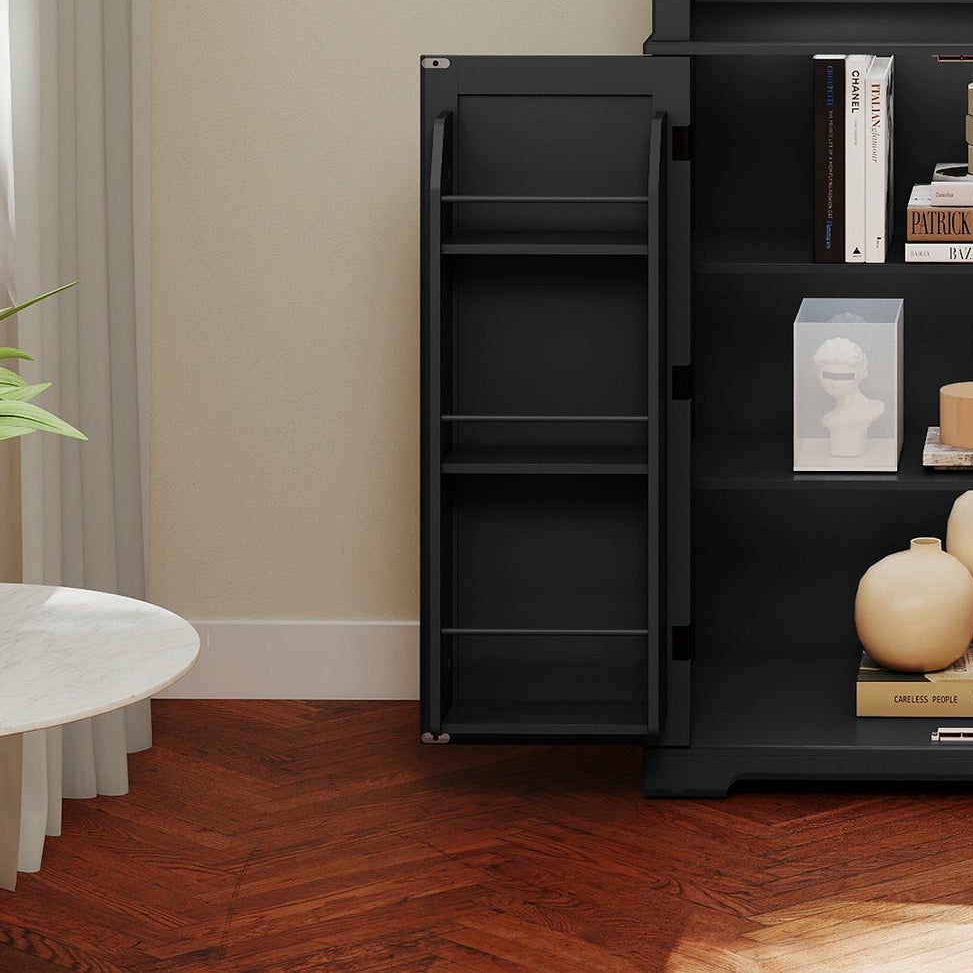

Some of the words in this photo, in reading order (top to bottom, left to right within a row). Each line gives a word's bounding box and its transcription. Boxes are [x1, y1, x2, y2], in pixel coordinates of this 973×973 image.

[851, 70, 860, 113] CHANEL
[871, 83, 880, 127] ITALIAN
[912, 211, 971, 235] PATRICK
[894, 696, 929, 704] CARELESS
[932, 696, 958, 704] PEOPLE
